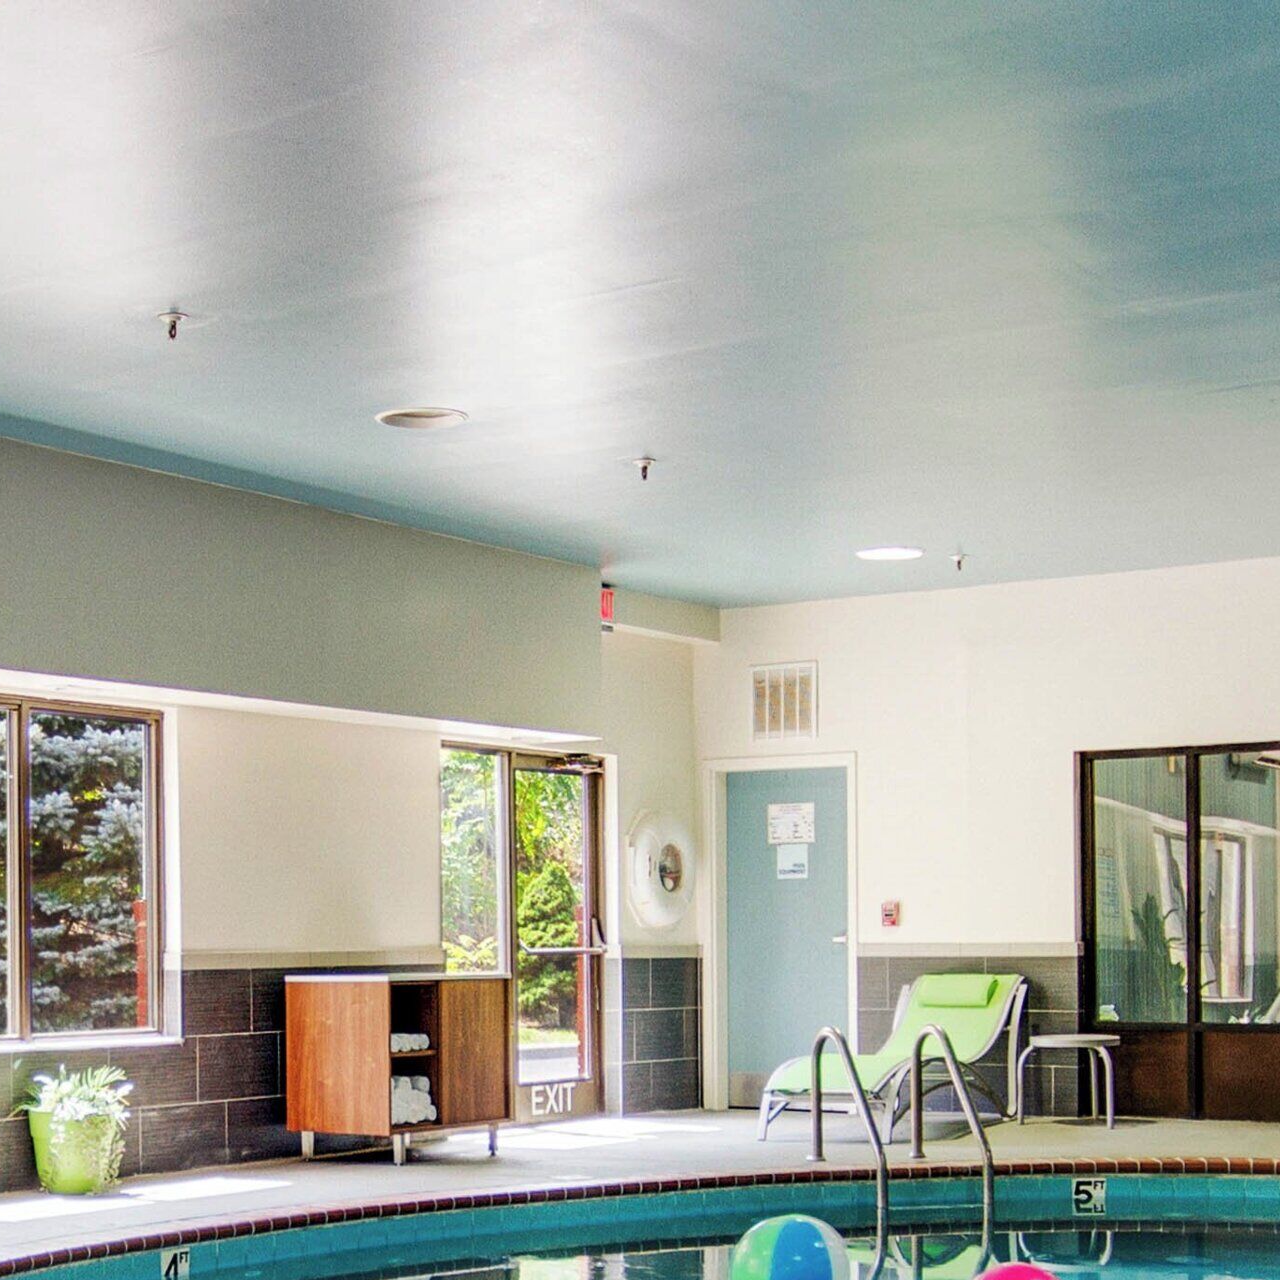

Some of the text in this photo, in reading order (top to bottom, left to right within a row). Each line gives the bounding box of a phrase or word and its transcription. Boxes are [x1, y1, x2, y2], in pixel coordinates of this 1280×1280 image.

[531, 1082, 576, 1116] EXIT
[1074, 1181, 1105, 1204] 5 FT
[180, 1251, 189, 1264] FT
